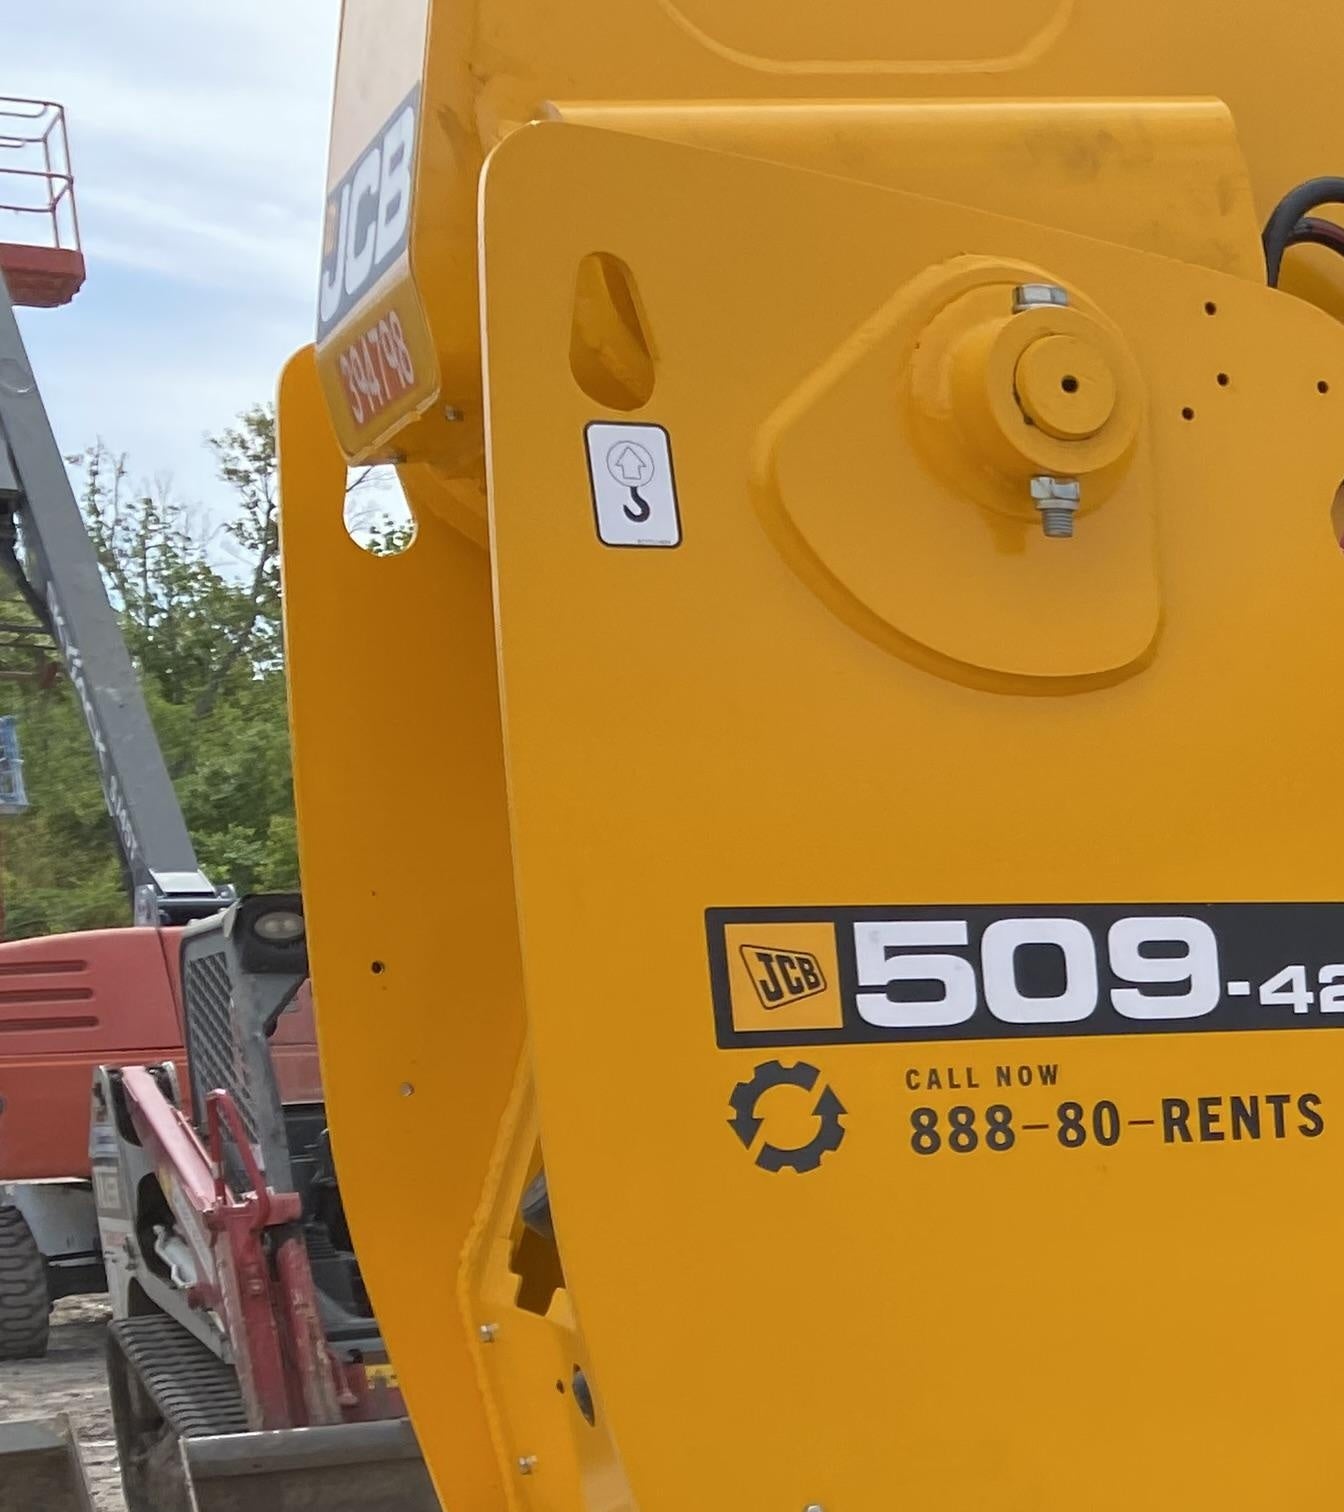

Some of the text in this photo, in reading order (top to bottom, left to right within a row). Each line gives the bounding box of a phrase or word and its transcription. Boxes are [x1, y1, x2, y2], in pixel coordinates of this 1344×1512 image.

[319, 105, 415, 323] JCB
[339, 309, 415, 425] 394798
[755, 951, 821, 1002] JCB
[905, 1063, 1060, 1091] CALL NOW
[909, 1093, 1326, 1155] 888-80-RENTS
